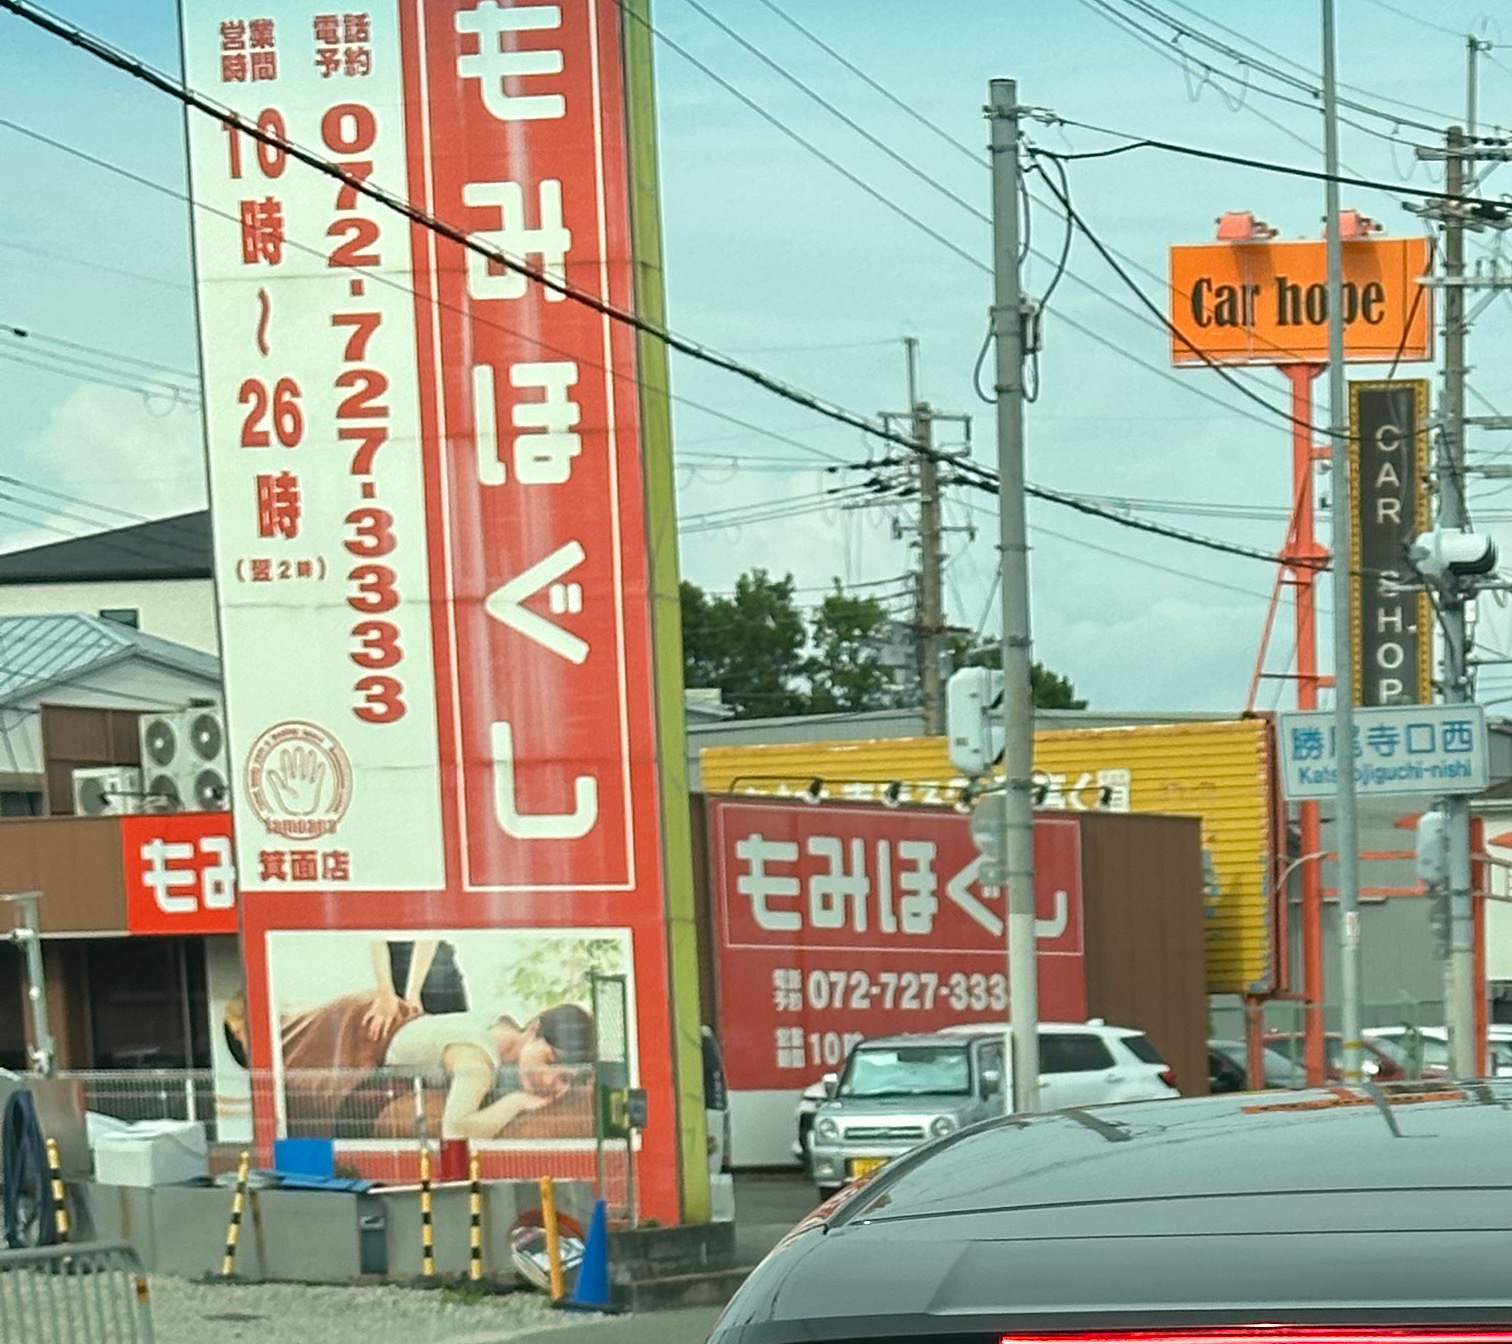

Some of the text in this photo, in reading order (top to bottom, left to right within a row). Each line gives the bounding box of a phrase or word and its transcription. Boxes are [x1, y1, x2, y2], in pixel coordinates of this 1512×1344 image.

[219, 18, 275, 51] 営業
[313, 13, 370, 45] 電話
[314, 46, 372, 79] 予約
[1191, 277, 1261, 328] Car
[455, 0, 599, 839] もみほぐし
[1374, 424, 1405, 705] CAR SHOP
[1299, 757, 1472, 785] Katsojiguchi-nishi
[807, 969, 1008, 1011] 072-727-333
